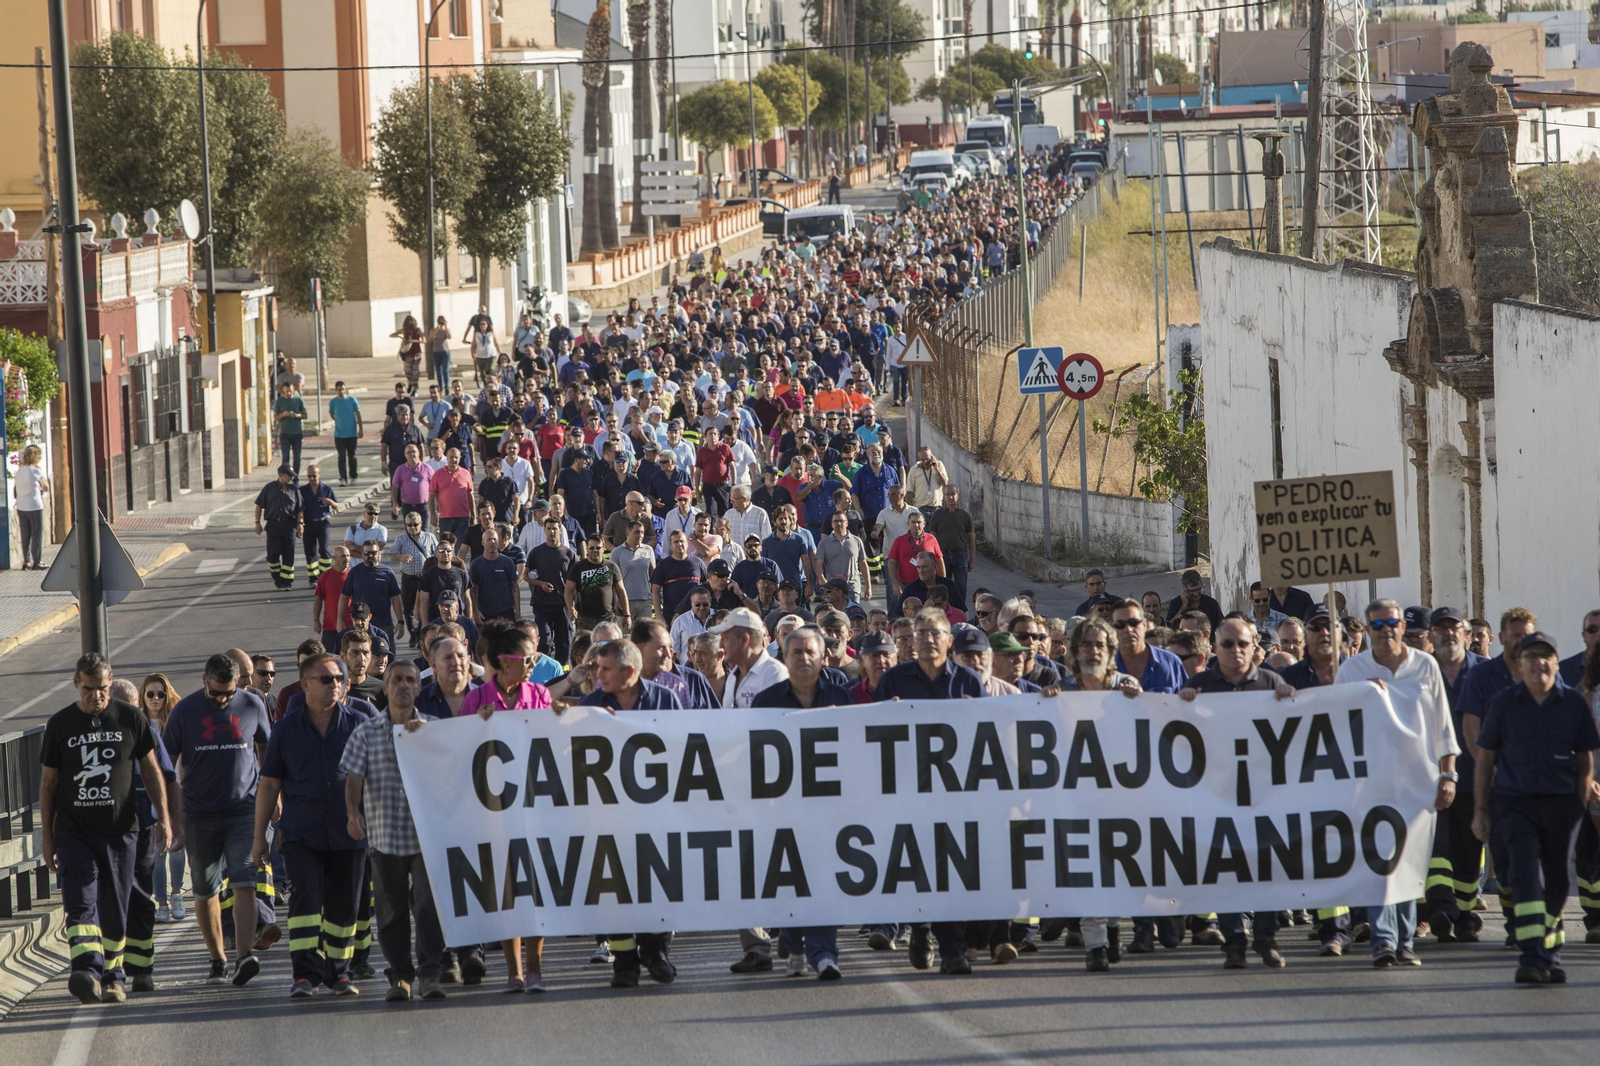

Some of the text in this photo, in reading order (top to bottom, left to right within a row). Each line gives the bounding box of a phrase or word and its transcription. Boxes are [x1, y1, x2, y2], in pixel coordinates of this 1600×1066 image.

[1256, 498, 1392, 526] ven a explicar tu
[1260, 525, 1376, 555] POLITICA
[67, 731, 123, 748] CABLES
[472, 708, 1368, 812] CARGA DE TRABAJO ¡YA!
[95, 799, 115, 807] PEDRO
[446, 805, 1407, 918] NAVANTIA SAN FERNANDO
